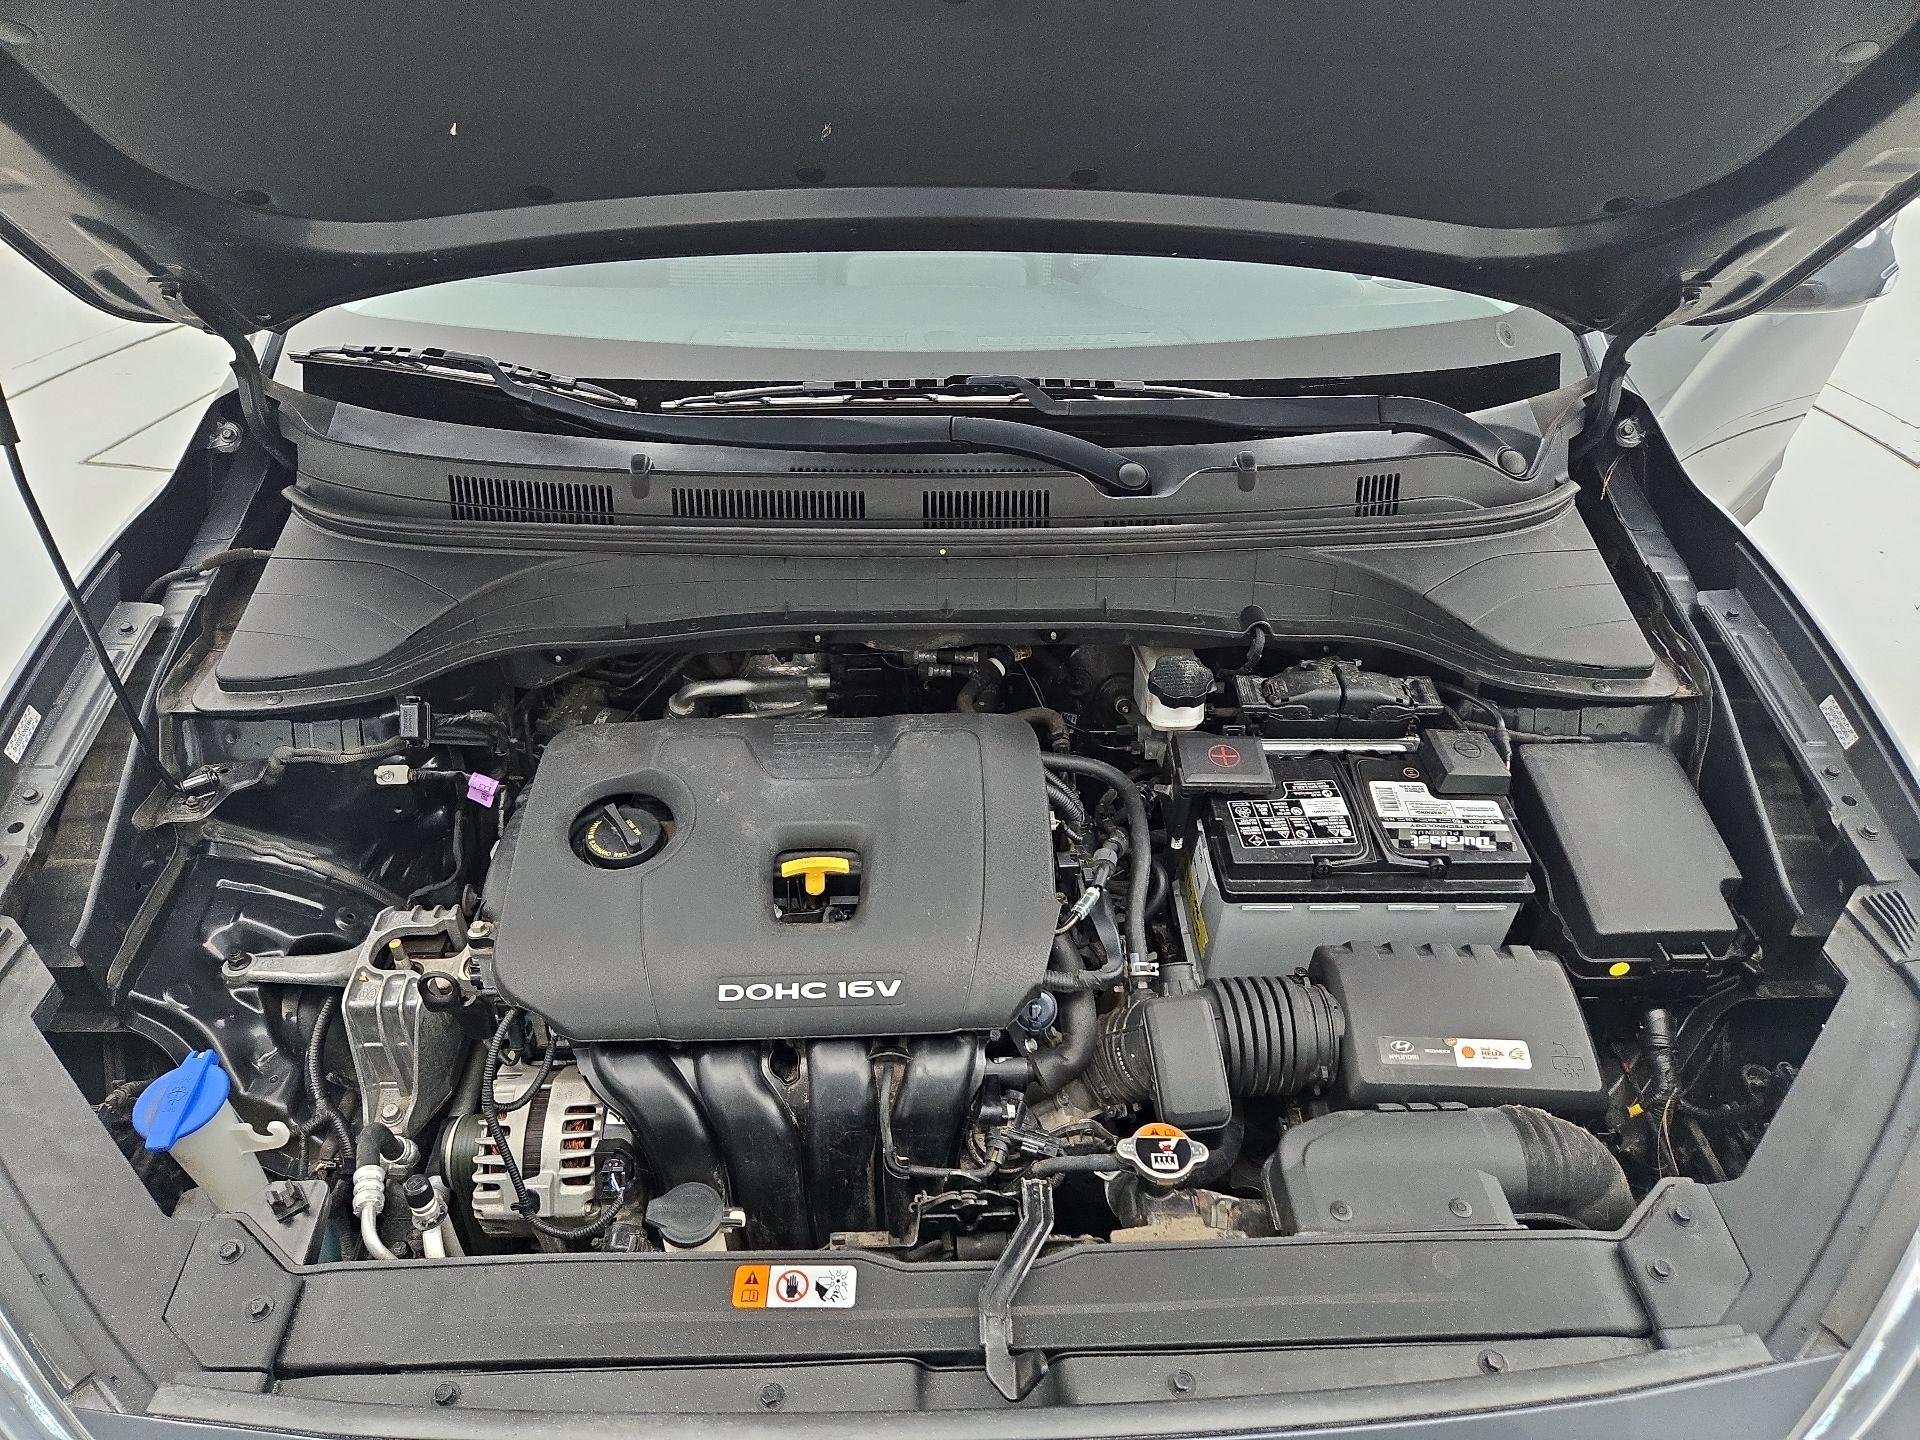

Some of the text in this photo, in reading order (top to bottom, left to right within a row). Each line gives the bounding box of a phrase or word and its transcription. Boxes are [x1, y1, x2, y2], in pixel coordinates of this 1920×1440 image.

[1410, 834, 1497, 851] Duralast
[718, 979, 902, 1002] DOHC 16V
[1388, 1053, 1420, 1061] HYUNDAI
